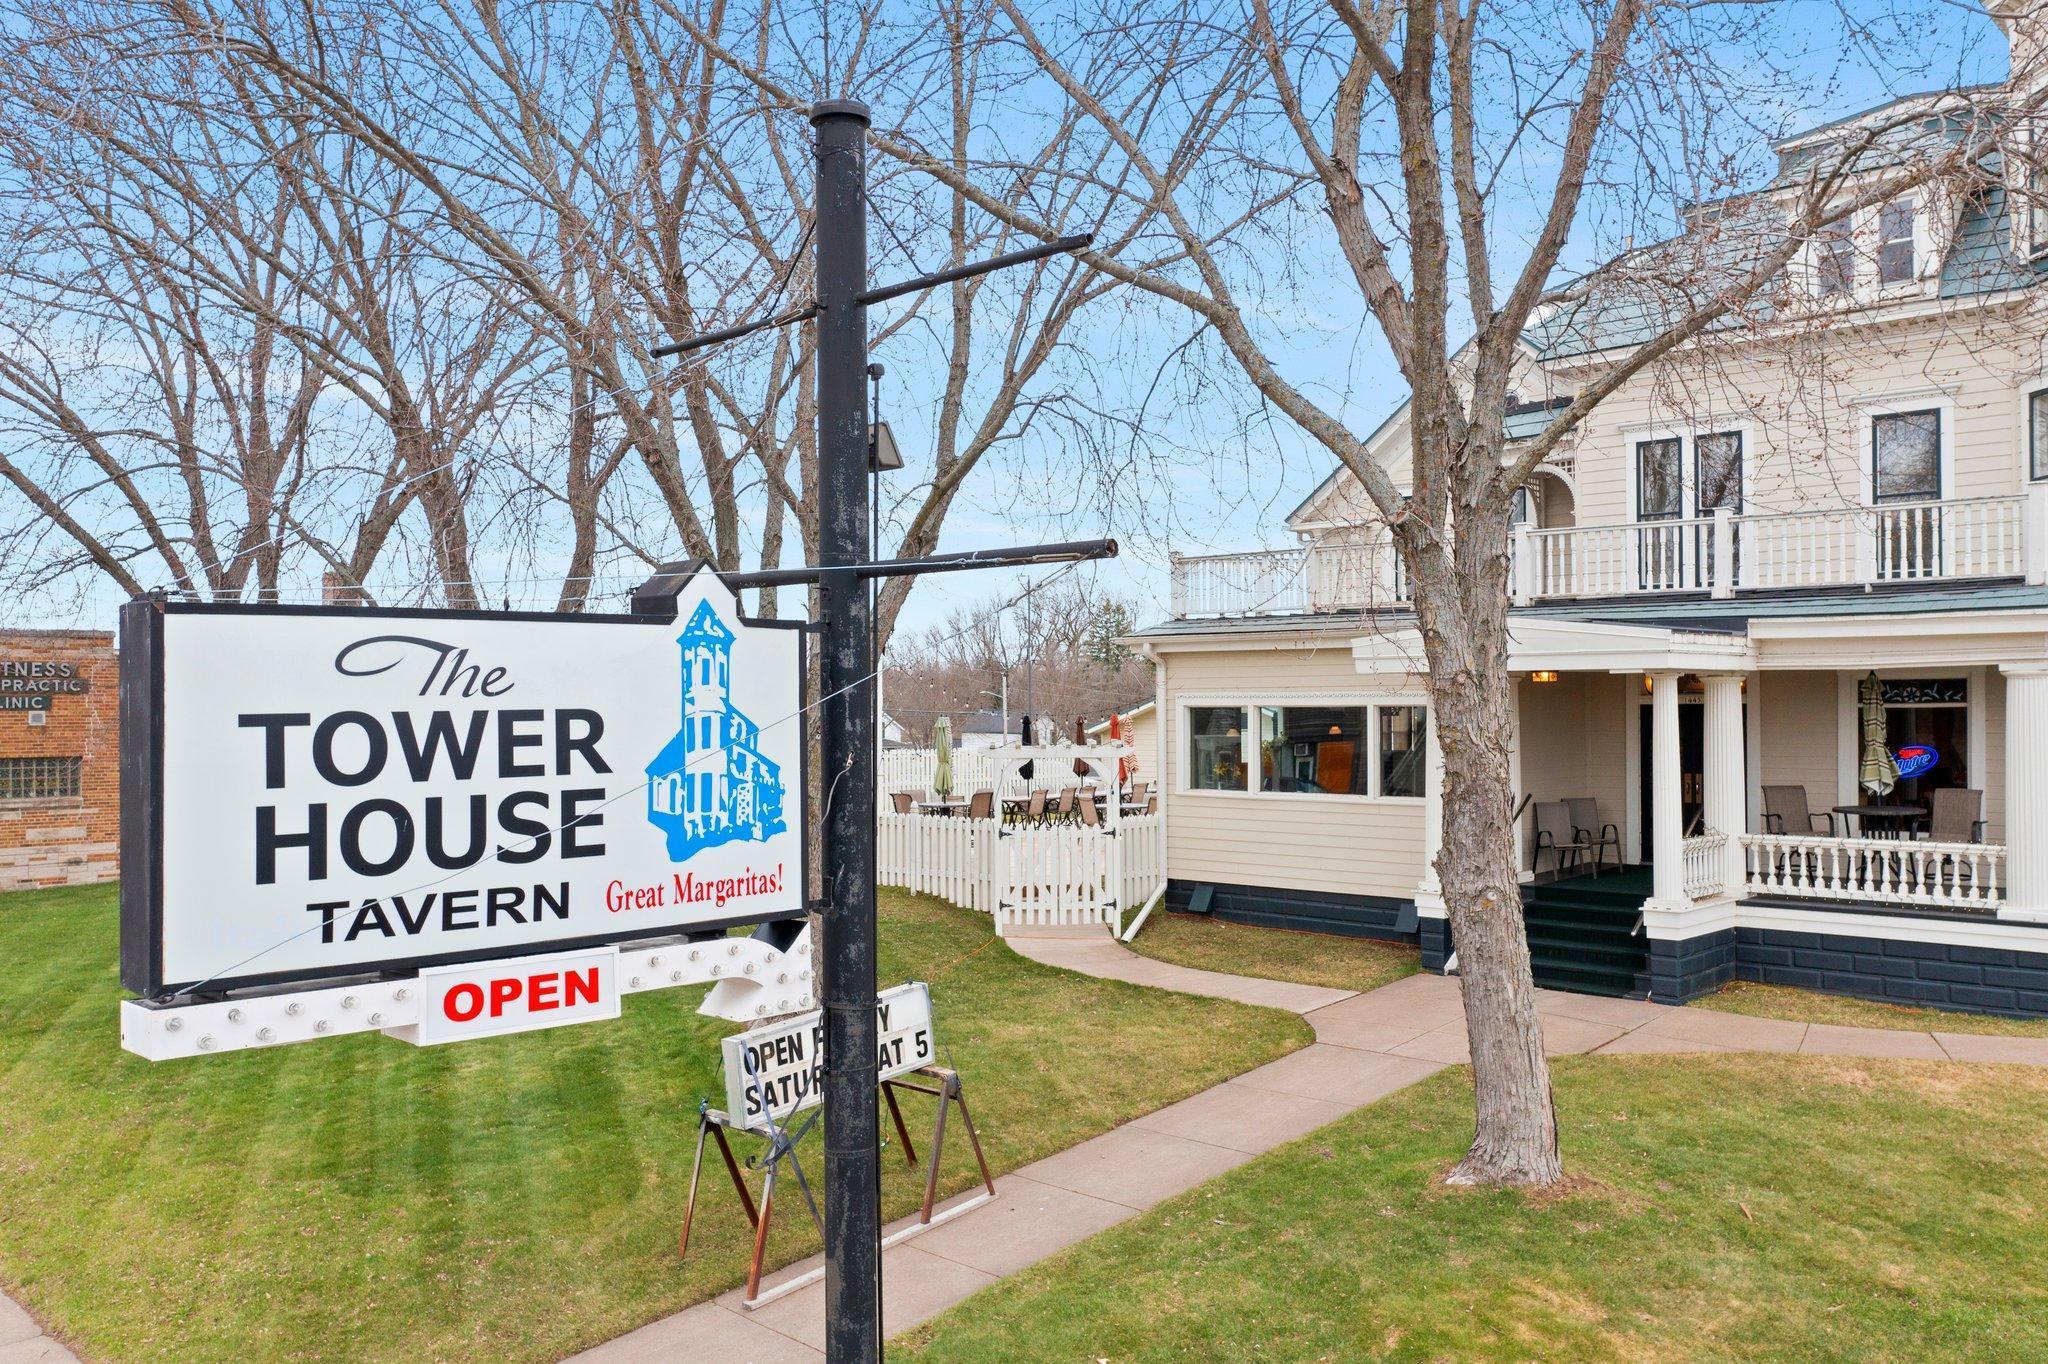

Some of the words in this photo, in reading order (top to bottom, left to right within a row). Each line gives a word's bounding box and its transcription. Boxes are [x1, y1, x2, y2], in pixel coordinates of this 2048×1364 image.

[1, 679, 81, 692] PRACTIC
[334, 634, 515, 698] The
[237, 708, 614, 790] TOWER
[255, 787, 606, 886] HOUSE
[305, 881, 570, 944] TAVERN
[606, 880, 665, 913] Great
[673, 863, 783, 908] Margaritas!
[443, 967, 600, 1023] OPEN
[744, 1031, 804, 1076] OPEN
[745, 1065, 824, 1116] SATUR
[878, 1037, 903, 1071] AT
[915, 1029, 928, 1058] 5
